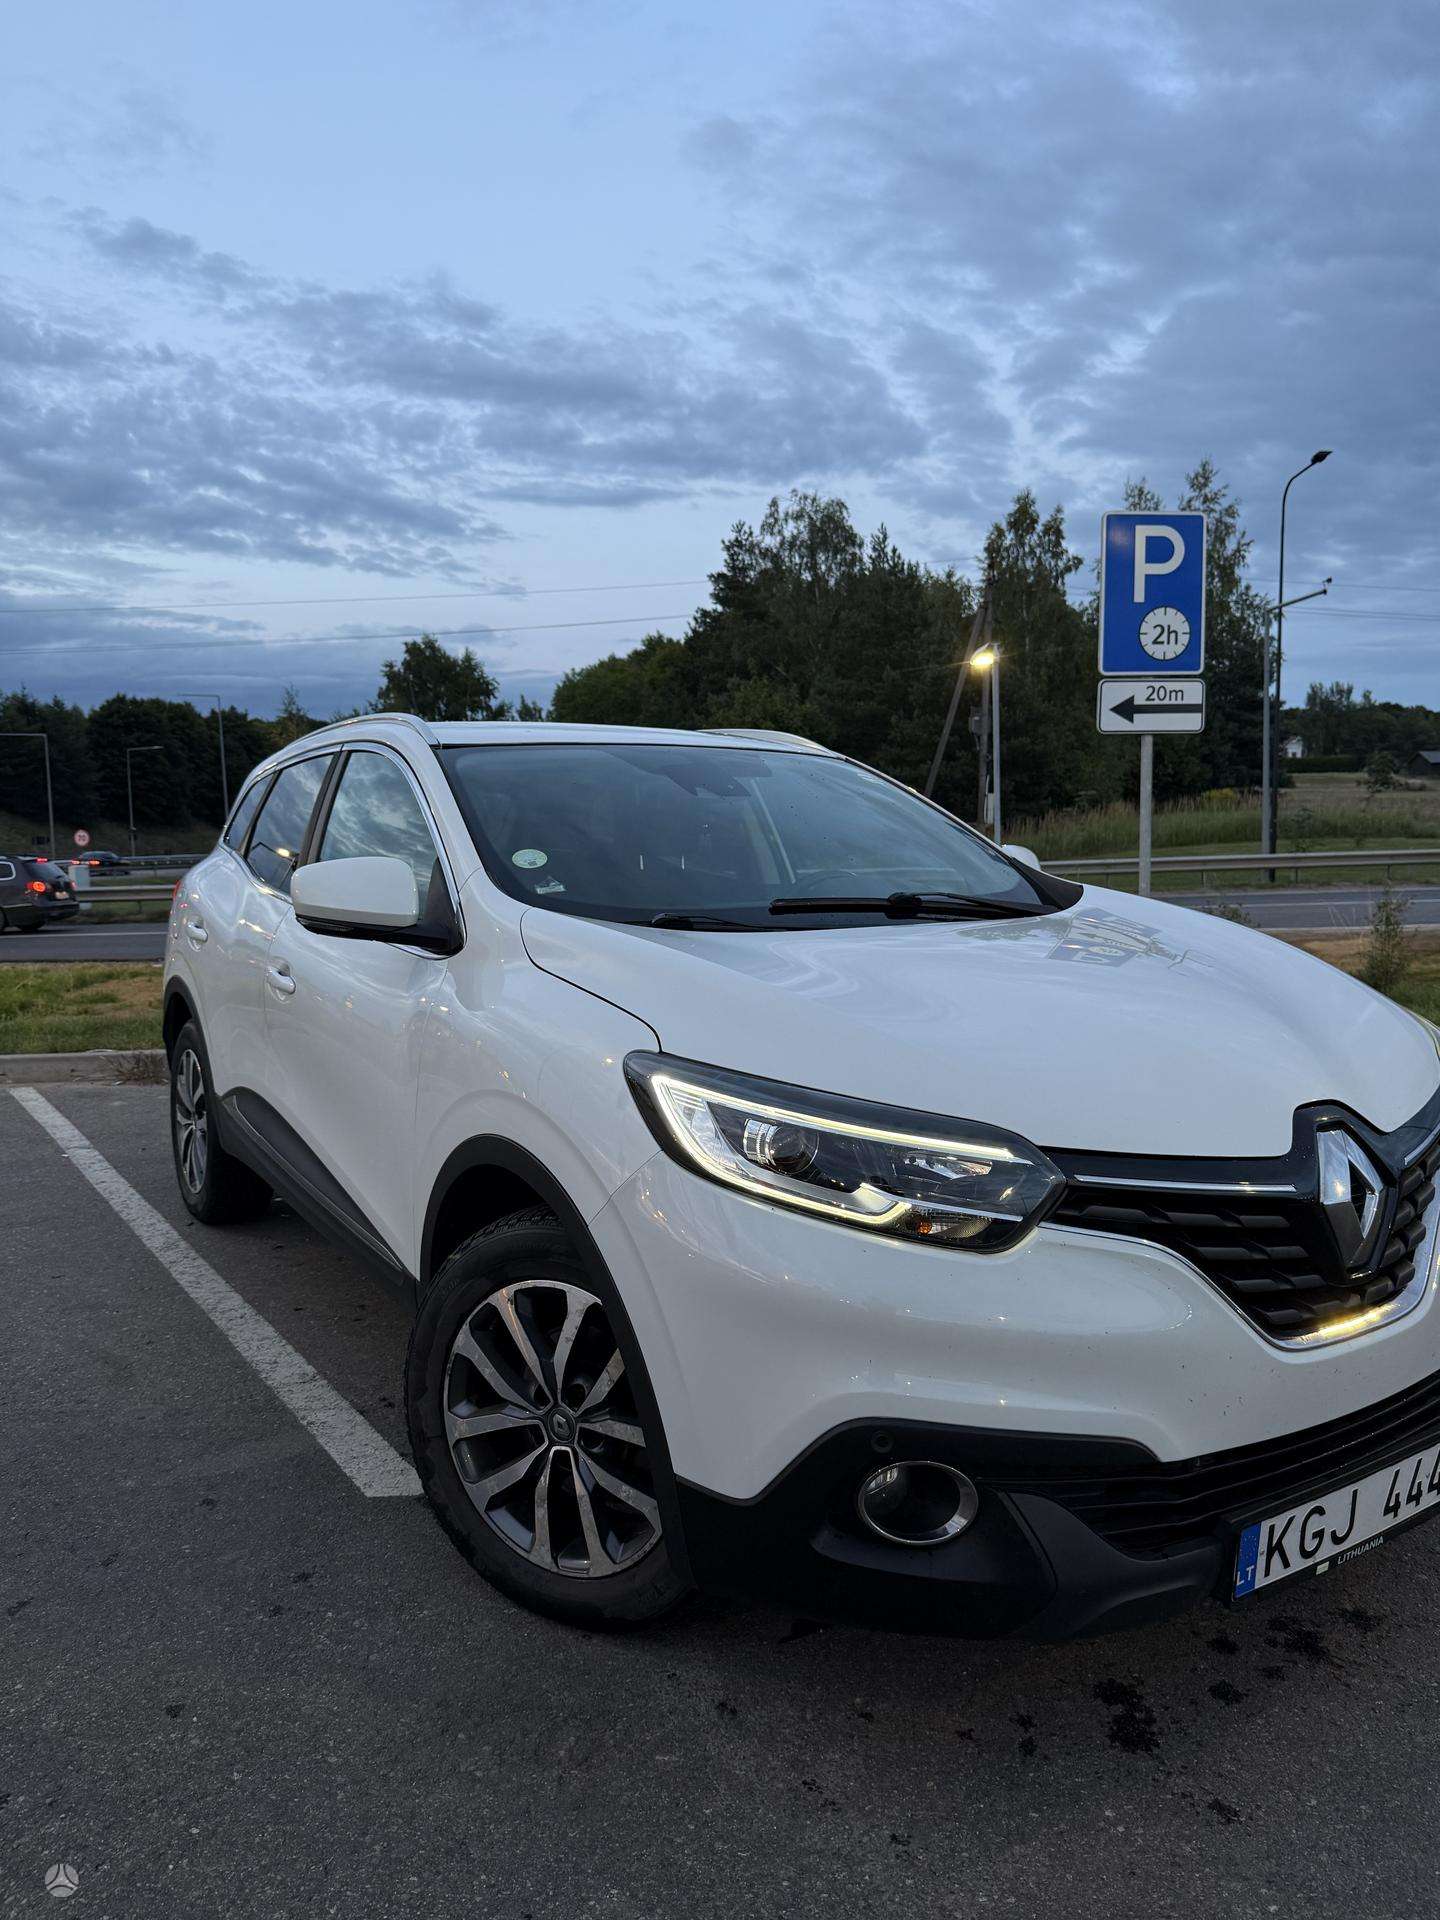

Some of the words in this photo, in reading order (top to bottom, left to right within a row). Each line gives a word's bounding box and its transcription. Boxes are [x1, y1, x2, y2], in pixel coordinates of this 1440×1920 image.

[1134, 525, 1185, 602] P
[1151, 624, 1178, 645] 2h
[1145, 685, 1184, 702] 20m
[1264, 1488, 1359, 1578] KGJ
[1337, 1535, 1384, 1565] LITHUANIA
[1236, 1564, 1255, 1586] LT
